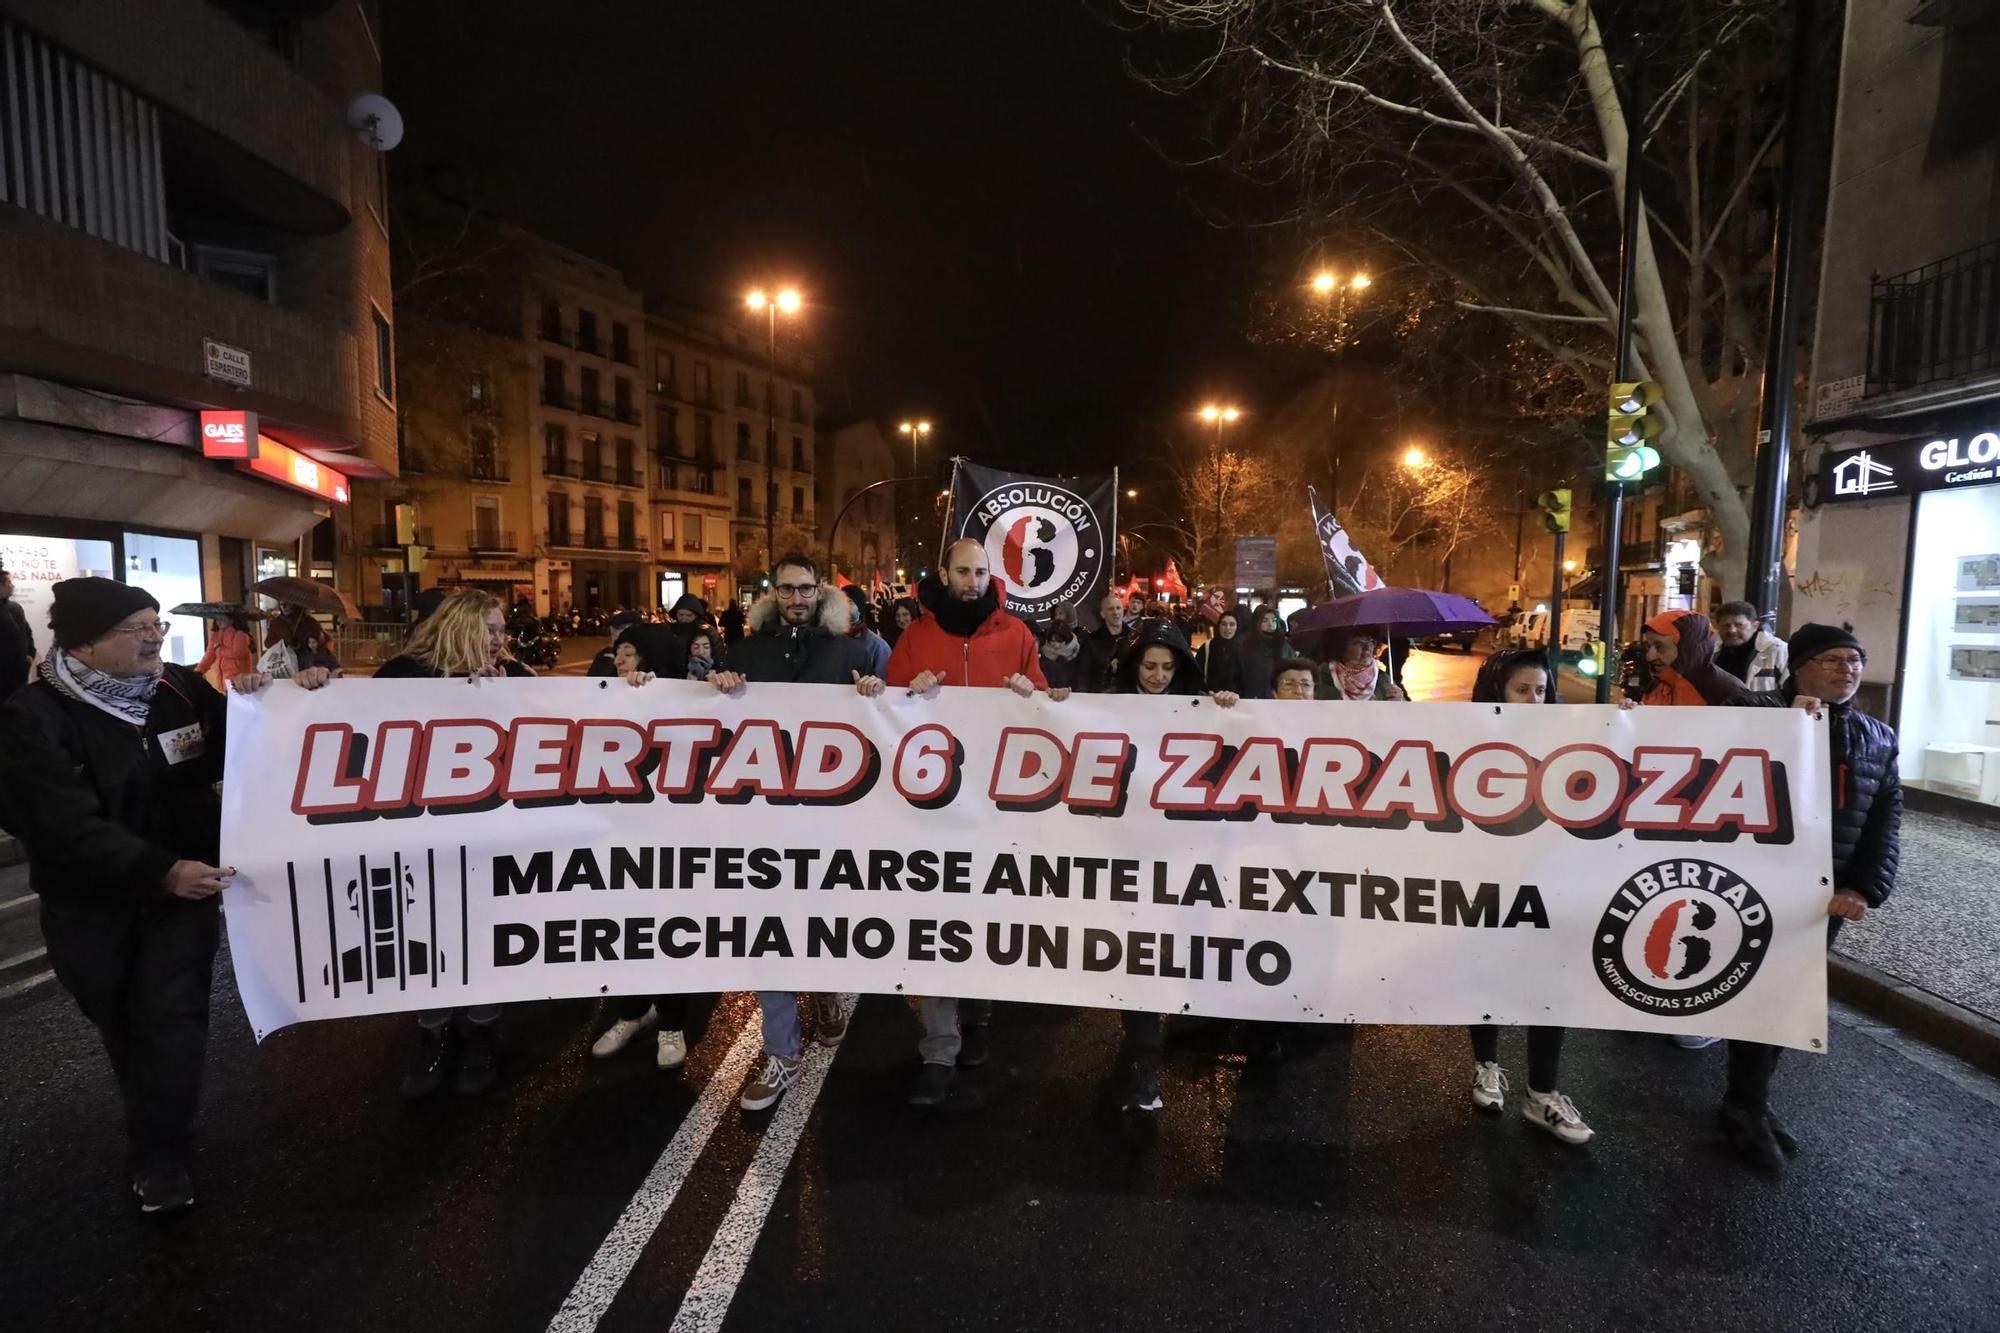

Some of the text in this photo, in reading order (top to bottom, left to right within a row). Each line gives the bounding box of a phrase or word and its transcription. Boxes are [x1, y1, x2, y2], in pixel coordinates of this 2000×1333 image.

[223, 351, 245, 366] CALLE
[204, 423, 245, 438] GAES
[1920, 432, 2000, 471] GLO
[1945, 467, 1993, 483] Gestión
[977, 488, 1091, 532] ABSOLUCIÓN
[21, 559, 40, 569] NO
[44, 559, 57, 570] TE
[31, 571, 63, 581] NADA
[290, 716, 1795, 846] LIBERTAD 6 DE ZARAGOZA
[492, 846, 1551, 929] MANIFESTARSE ANTE LA EXTREMA
[1608, 861, 1767, 927] LIBERTAD
[493, 916, 1292, 987] DERECHA NO ES UN DELITO
[1601, 956, 1752, 1009] ANTIFASCISTAS ZARAGOZA
